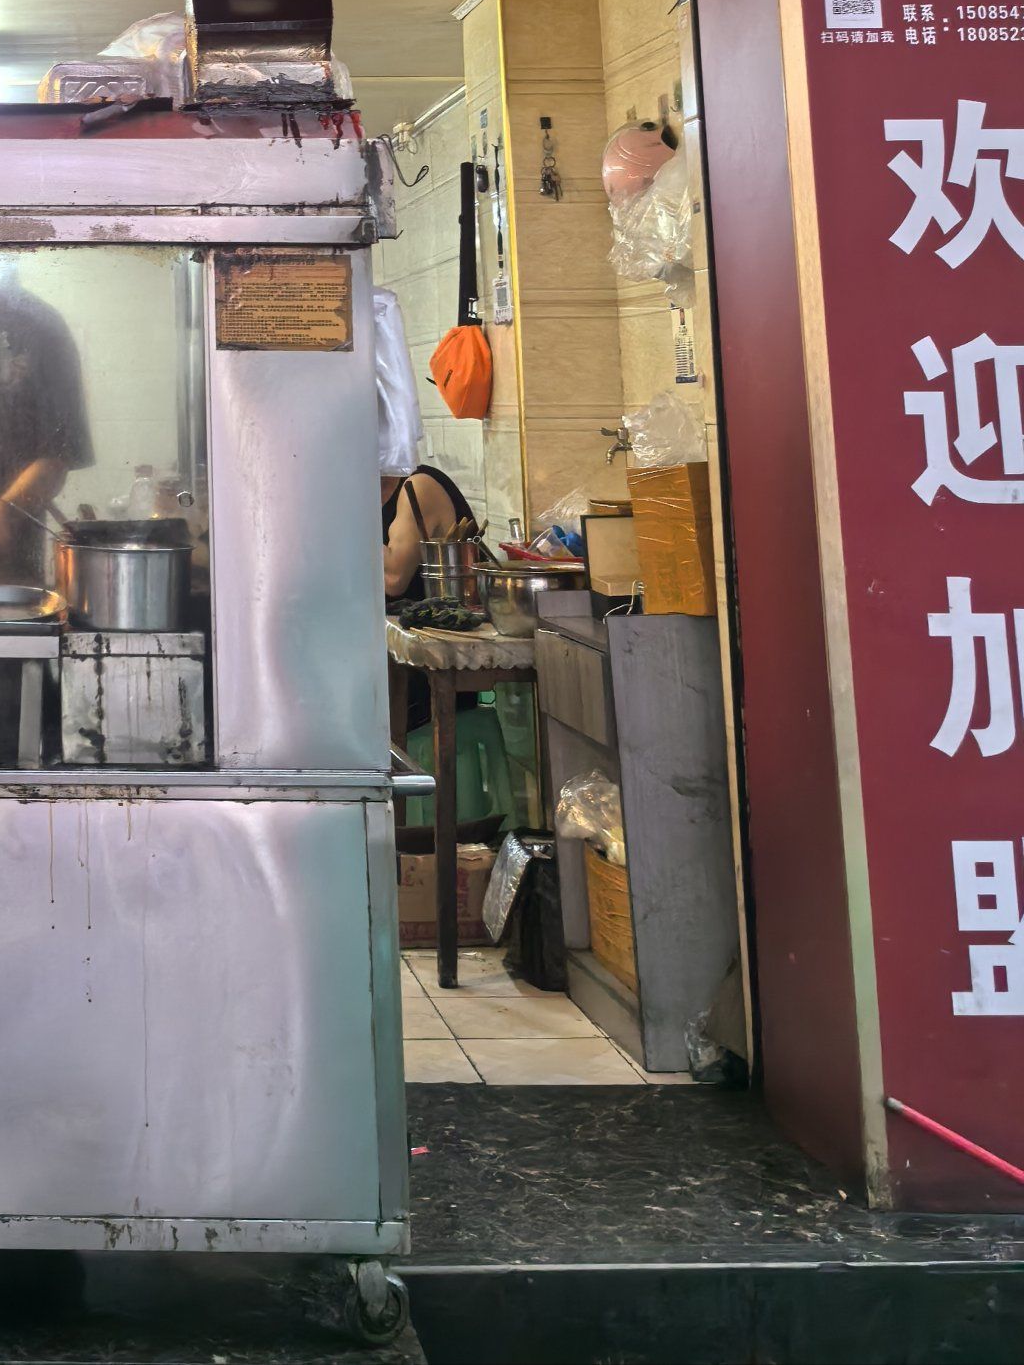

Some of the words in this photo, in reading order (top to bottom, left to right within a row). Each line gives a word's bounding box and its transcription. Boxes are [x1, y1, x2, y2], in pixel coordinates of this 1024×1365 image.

[902, 3, 935, 22] 联系
[820, 30, 895, 44] 扫码请加我
[905, 26, 937, 45] 电话
